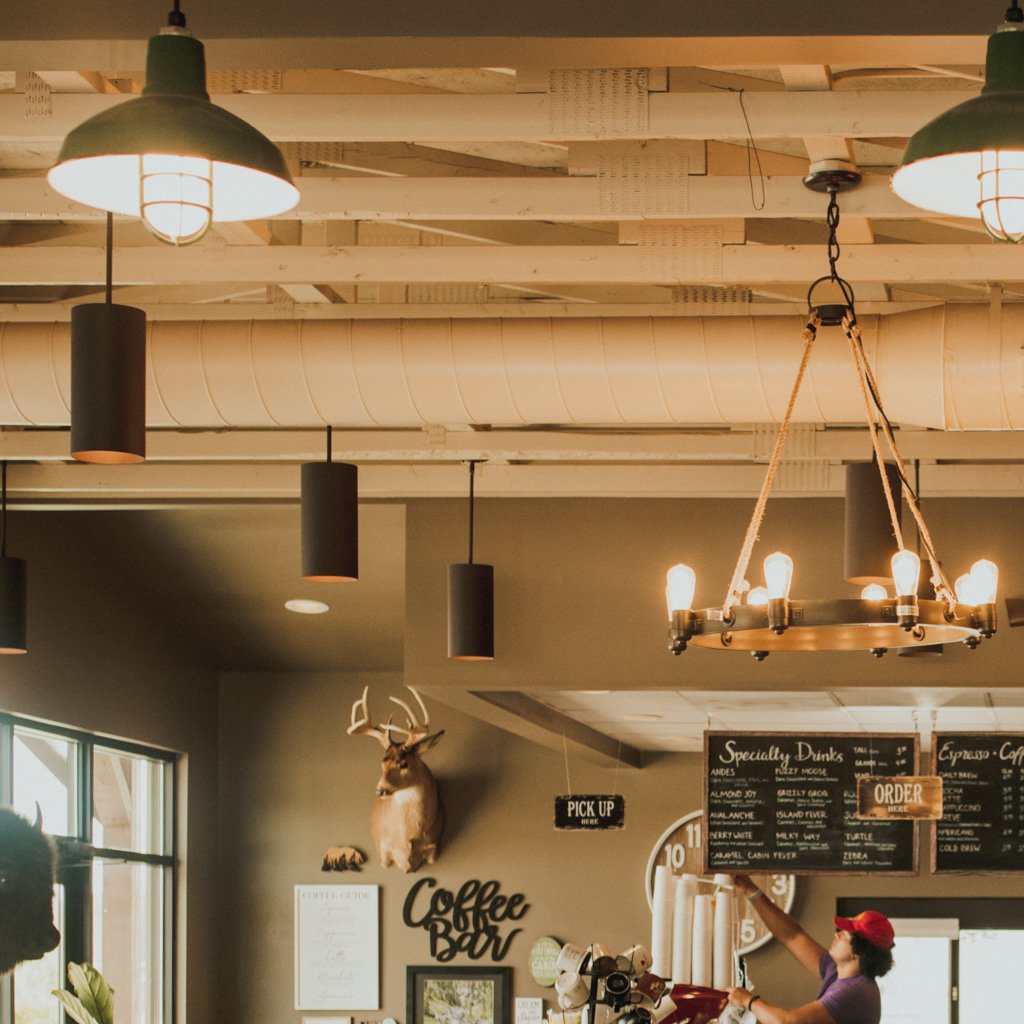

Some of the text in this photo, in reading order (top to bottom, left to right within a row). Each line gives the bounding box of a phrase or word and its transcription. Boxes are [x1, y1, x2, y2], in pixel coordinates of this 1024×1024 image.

[719, 740, 844, 769] Specialty Drinks
[938, 741, 990, 767] Espresso
[710, 768, 736, 777] ANDES
[801, 768, 828, 776] MOOSE
[958, 770, 978, 779] BREW
[710, 789, 757, 799] ALMOND JOY
[777, 789, 828, 798] GRIZZLY GROG
[874, 783, 923, 804] ORDER
[942, 787, 964, 795] OCHA
[943, 795, 961, 803] ATTE
[567, 800, 615, 817] PICK UP
[887, 805, 909, 813] HERE
[943, 804, 981, 812] APPUCCINO
[709, 811, 755, 820] AVALANCHE
[776, 811, 828, 819] ISLAND FEVER
[942, 813, 961, 822] REVE
[686, 823, 700, 848] 11
[709, 831, 753, 840] BERRY WHITE
[775, 832, 821, 841] MILKY WAY
[845, 832, 873, 841] TURTLE
[939, 844, 981, 852] COLD BREW
[665, 843, 685, 868] 10
[710, 851, 798, 860] CARAMEL CABIN FEVER
[842, 851, 869, 860] ZEBRA
[771, 875, 787, 895] 3
[302, 892, 337, 900] COFFEE
[402, 877, 530, 931] Coffee
[740, 919, 756, 943] 5
[429, 918, 523, 962] Bar
